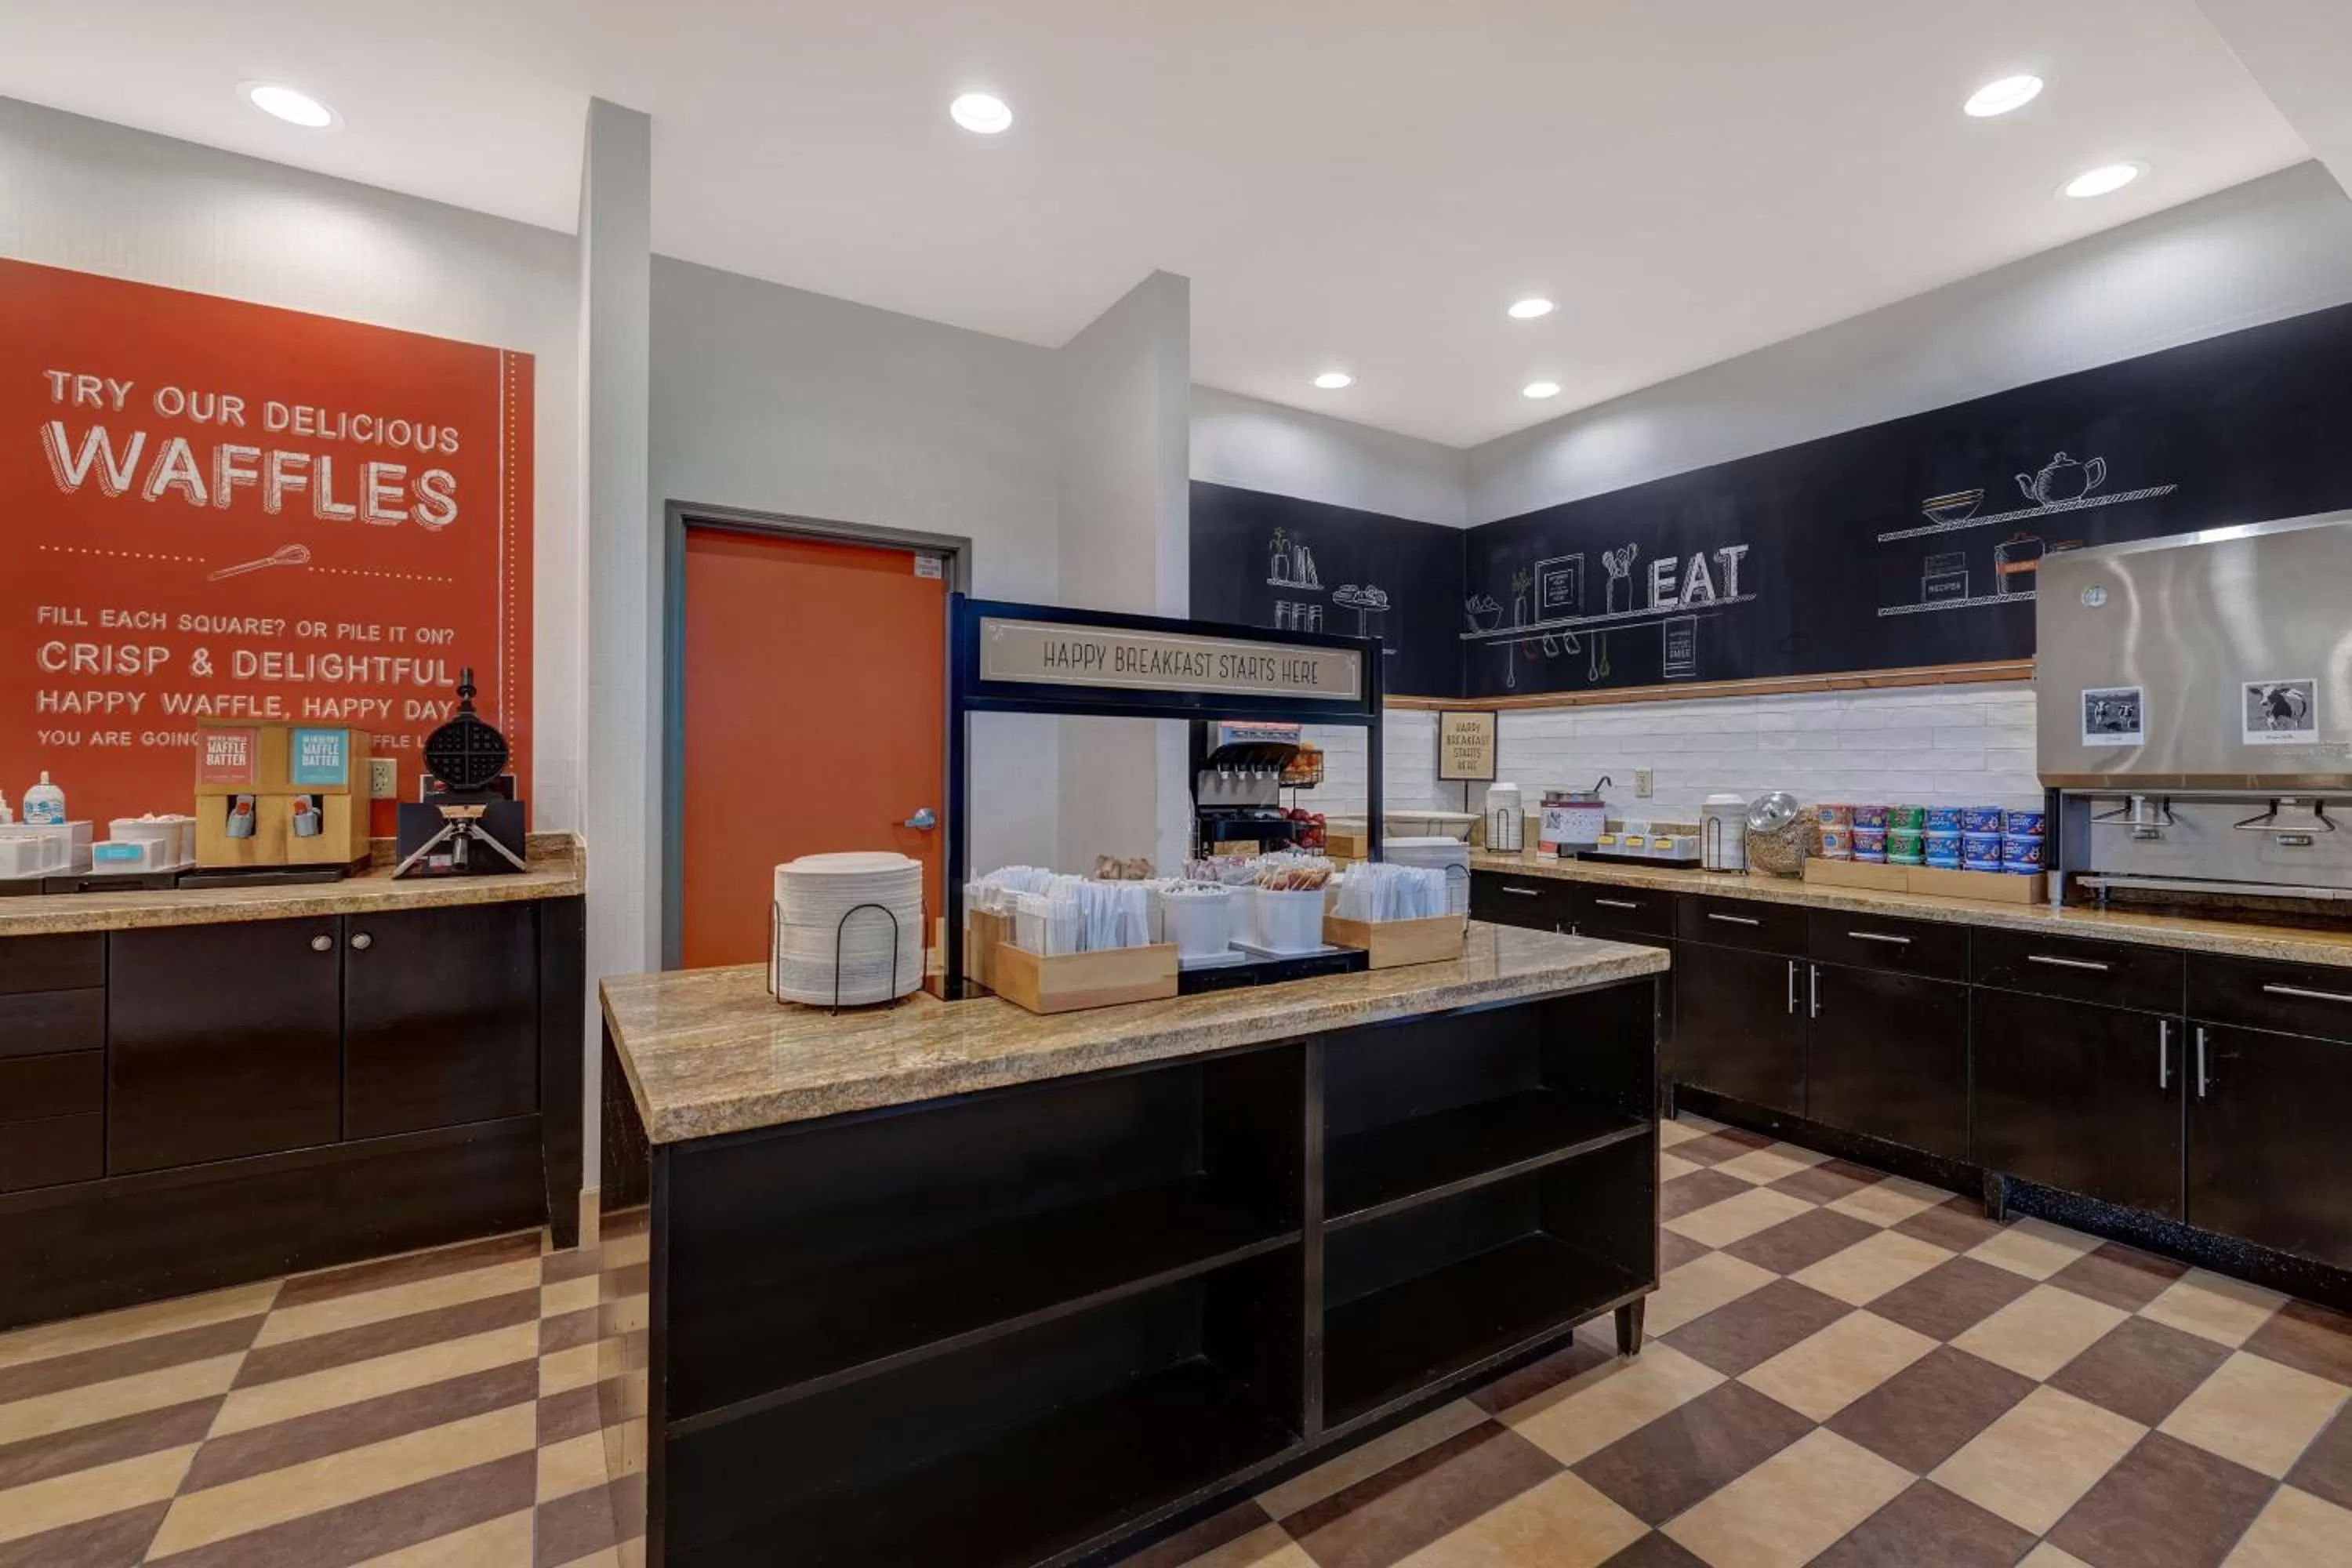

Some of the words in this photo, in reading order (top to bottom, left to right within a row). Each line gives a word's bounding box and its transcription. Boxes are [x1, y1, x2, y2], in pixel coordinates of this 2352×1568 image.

[44, 369, 134, 411] TRY
[154, 387, 245, 425] OUR
[263, 401, 459, 454] DELICIOUS
[39, 420, 459, 531] WAFFLES
[1649, 544, 1749, 609] EAT
[36, 606, 89, 627] FILL
[100, 609, 167, 630] EACH
[177, 614, 285, 637] SQUARE?
[296, 620, 327, 640] OR
[336, 624, 380, 642] PILE
[389, 626, 406, 643] IT
[416, 627, 455, 645] ON?
[36, 641, 170, 675] CRISP
[191, 648, 214, 677] &
[232, 651, 454, 685] DELIGHTFUL
[1044, 641, 1105, 667] HAPPY
[1115, 647, 1213, 678] BREAKFAST
[1219, 655, 1275, 681] STARTS
[1282, 659, 1319, 684] HERE
[37, 689, 147, 714] HAPPY
[162, 693, 291, 720] WAFFLE,
[303, 697, 393, 719] HAPPY
[403, 700, 454, 722] DAY
[38, 730, 81, 746] YOU
[89, 730, 132, 747] ARE
[208, 742, 247, 754] WAFFLE
[303, 744, 339, 755] WAFFLE
[372, 735, 410, 749] FFLE
[206, 754, 246, 766] BATTER
[302, 755, 339, 766] BATTER
